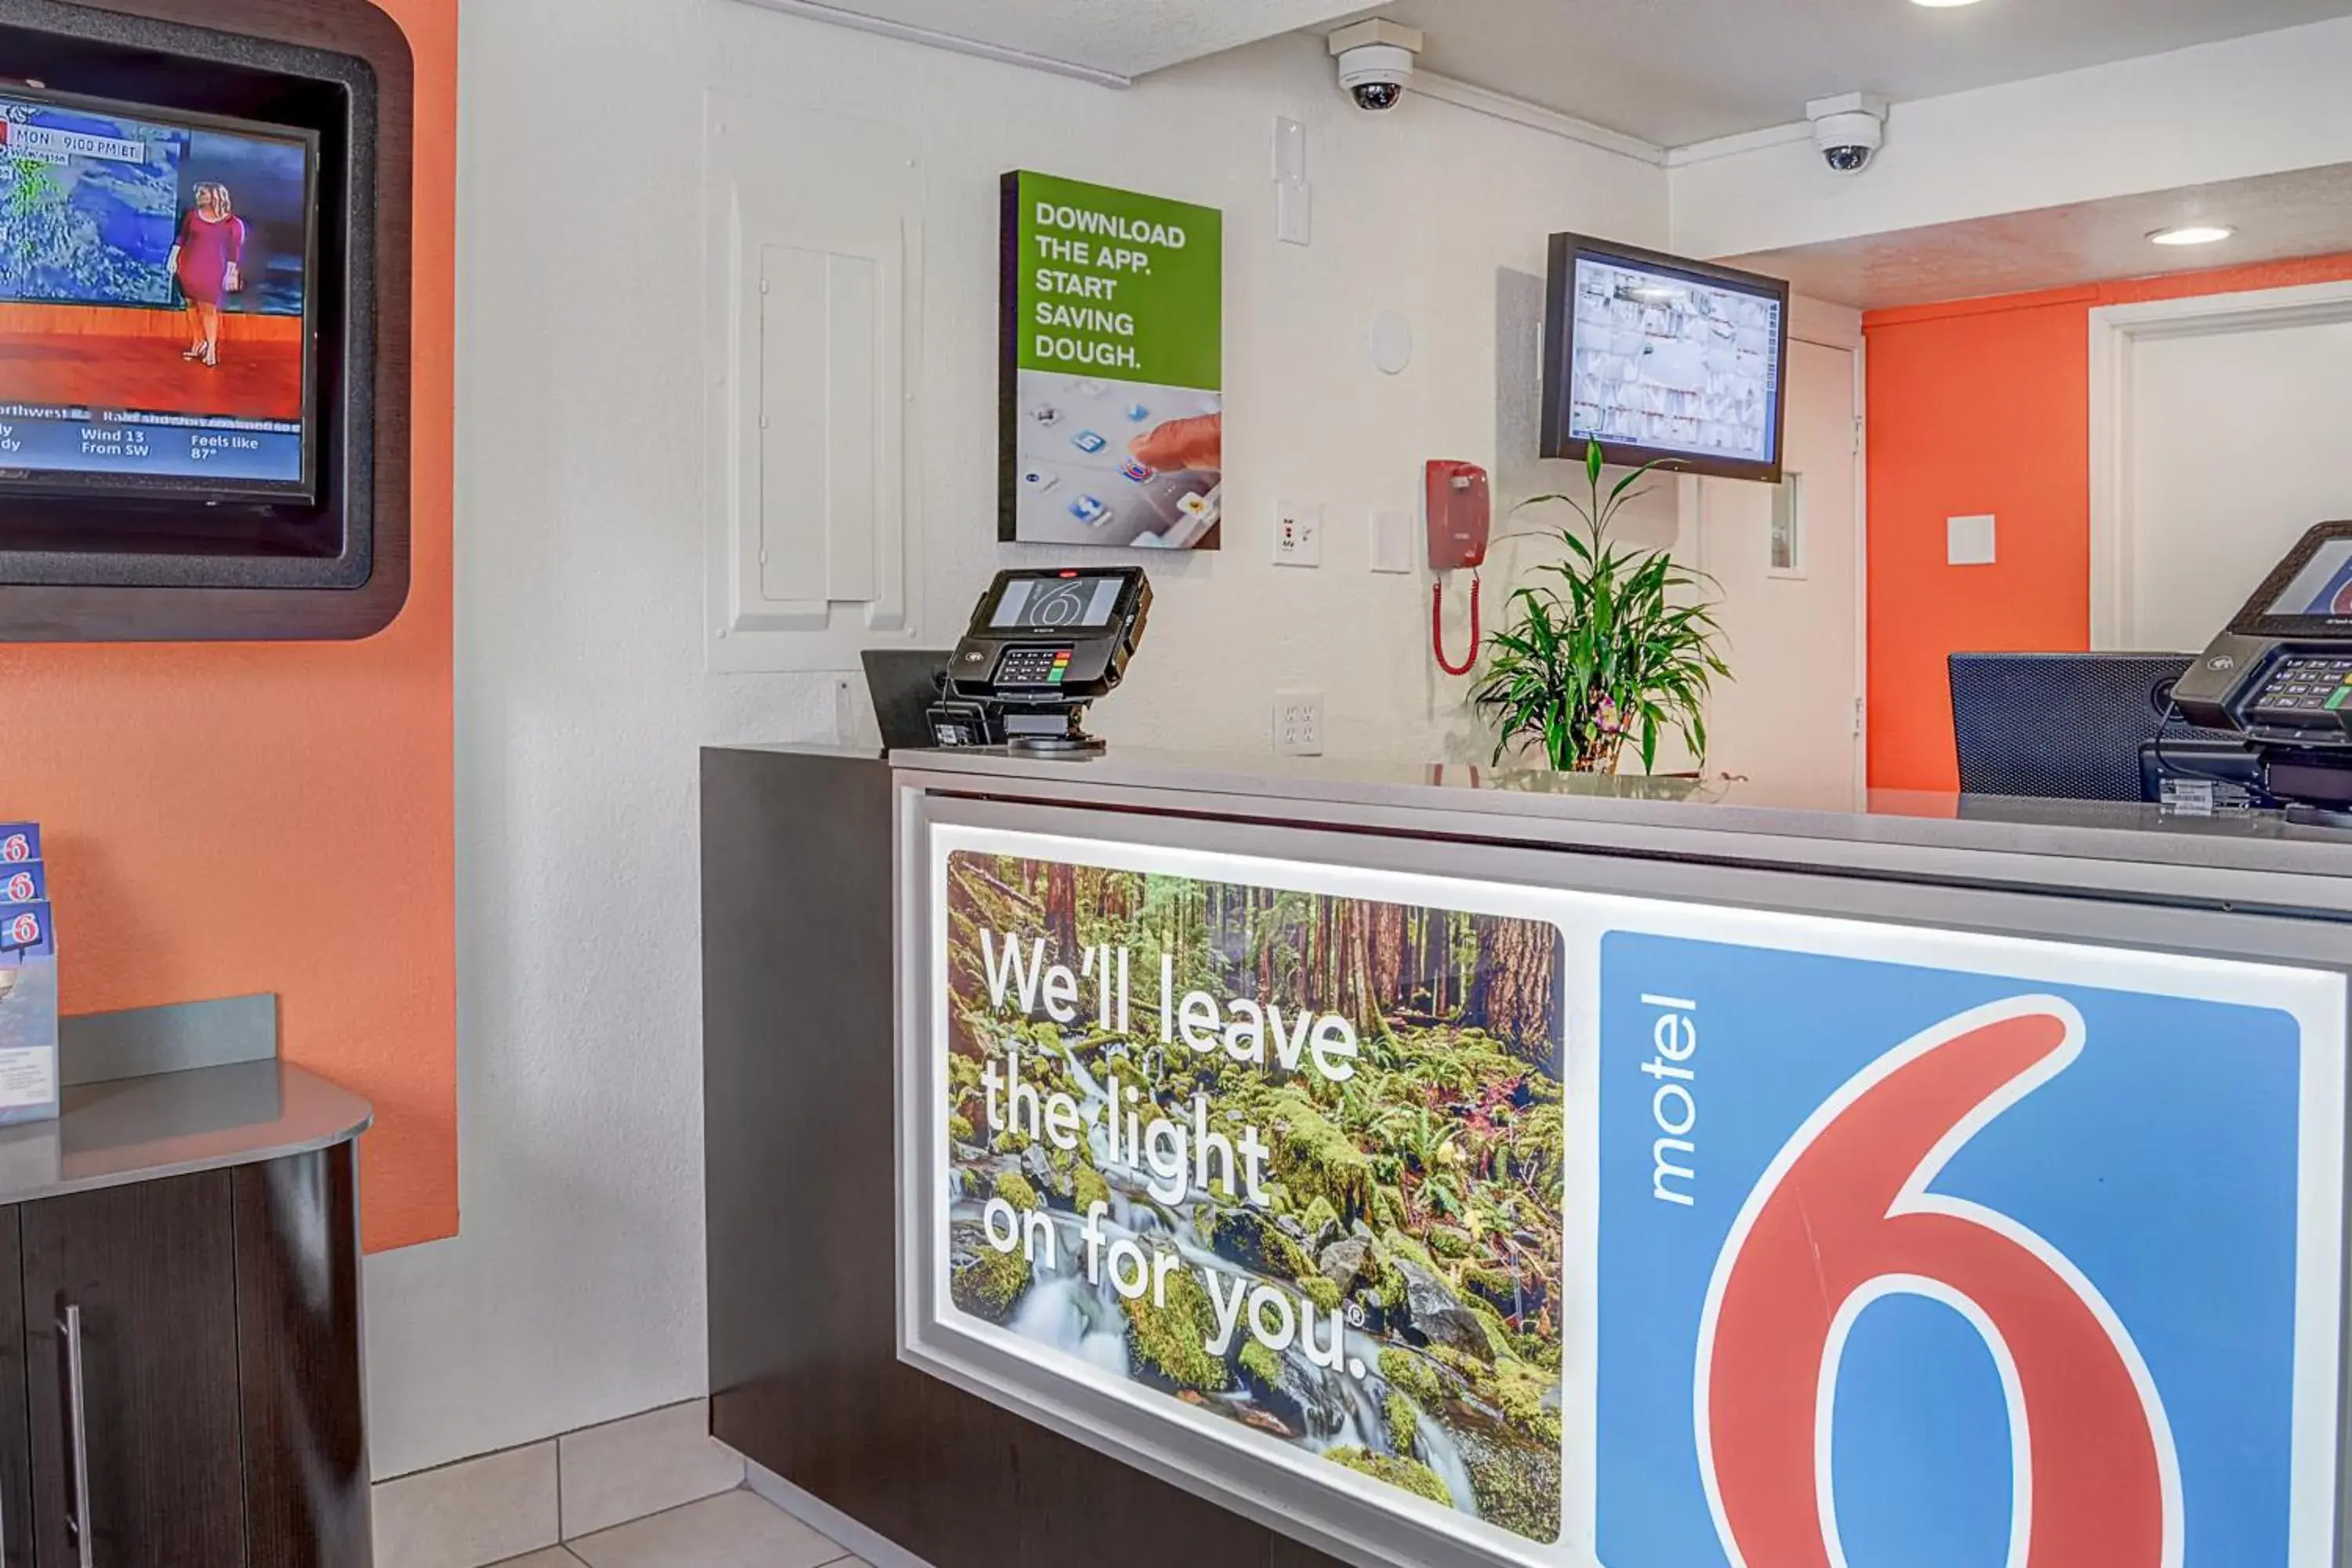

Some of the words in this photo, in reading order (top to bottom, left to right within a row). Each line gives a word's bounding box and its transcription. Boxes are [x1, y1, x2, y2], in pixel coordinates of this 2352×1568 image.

[17, 130, 49, 145] MON
[1036, 201, 1185, 249] DOWNLOAD
[1035, 234, 1089, 265] THE
[1096, 246, 1151, 275] APP.
[1035, 268, 1117, 300] START
[1035, 301, 1134, 336] SAVING
[1035, 335, 1141, 369] DOUGH.
[82, 428, 122, 441] Wind
[126, 430, 144, 443] 13
[82, 442, 121, 456] From
[125, 445, 150, 457] SW
[191, 435, 229, 448] Feels
[1029, 581, 1082, 626] 6
[4, 834, 29, 862] 6
[9, 872, 34, 902] 6
[13, 913, 38, 942] 6
[979, 927, 1128, 1034] We'll
[1160, 953, 1358, 1082] leave
[982, 1051, 1080, 1150] the
[1109, 1076, 1270, 1207] light
[983, 1197, 1055, 1271] on
[1081, 1201, 1179, 1308] for
[1641, 993, 1697, 1206] motel
[1693, 993, 2184, 1568] 6
